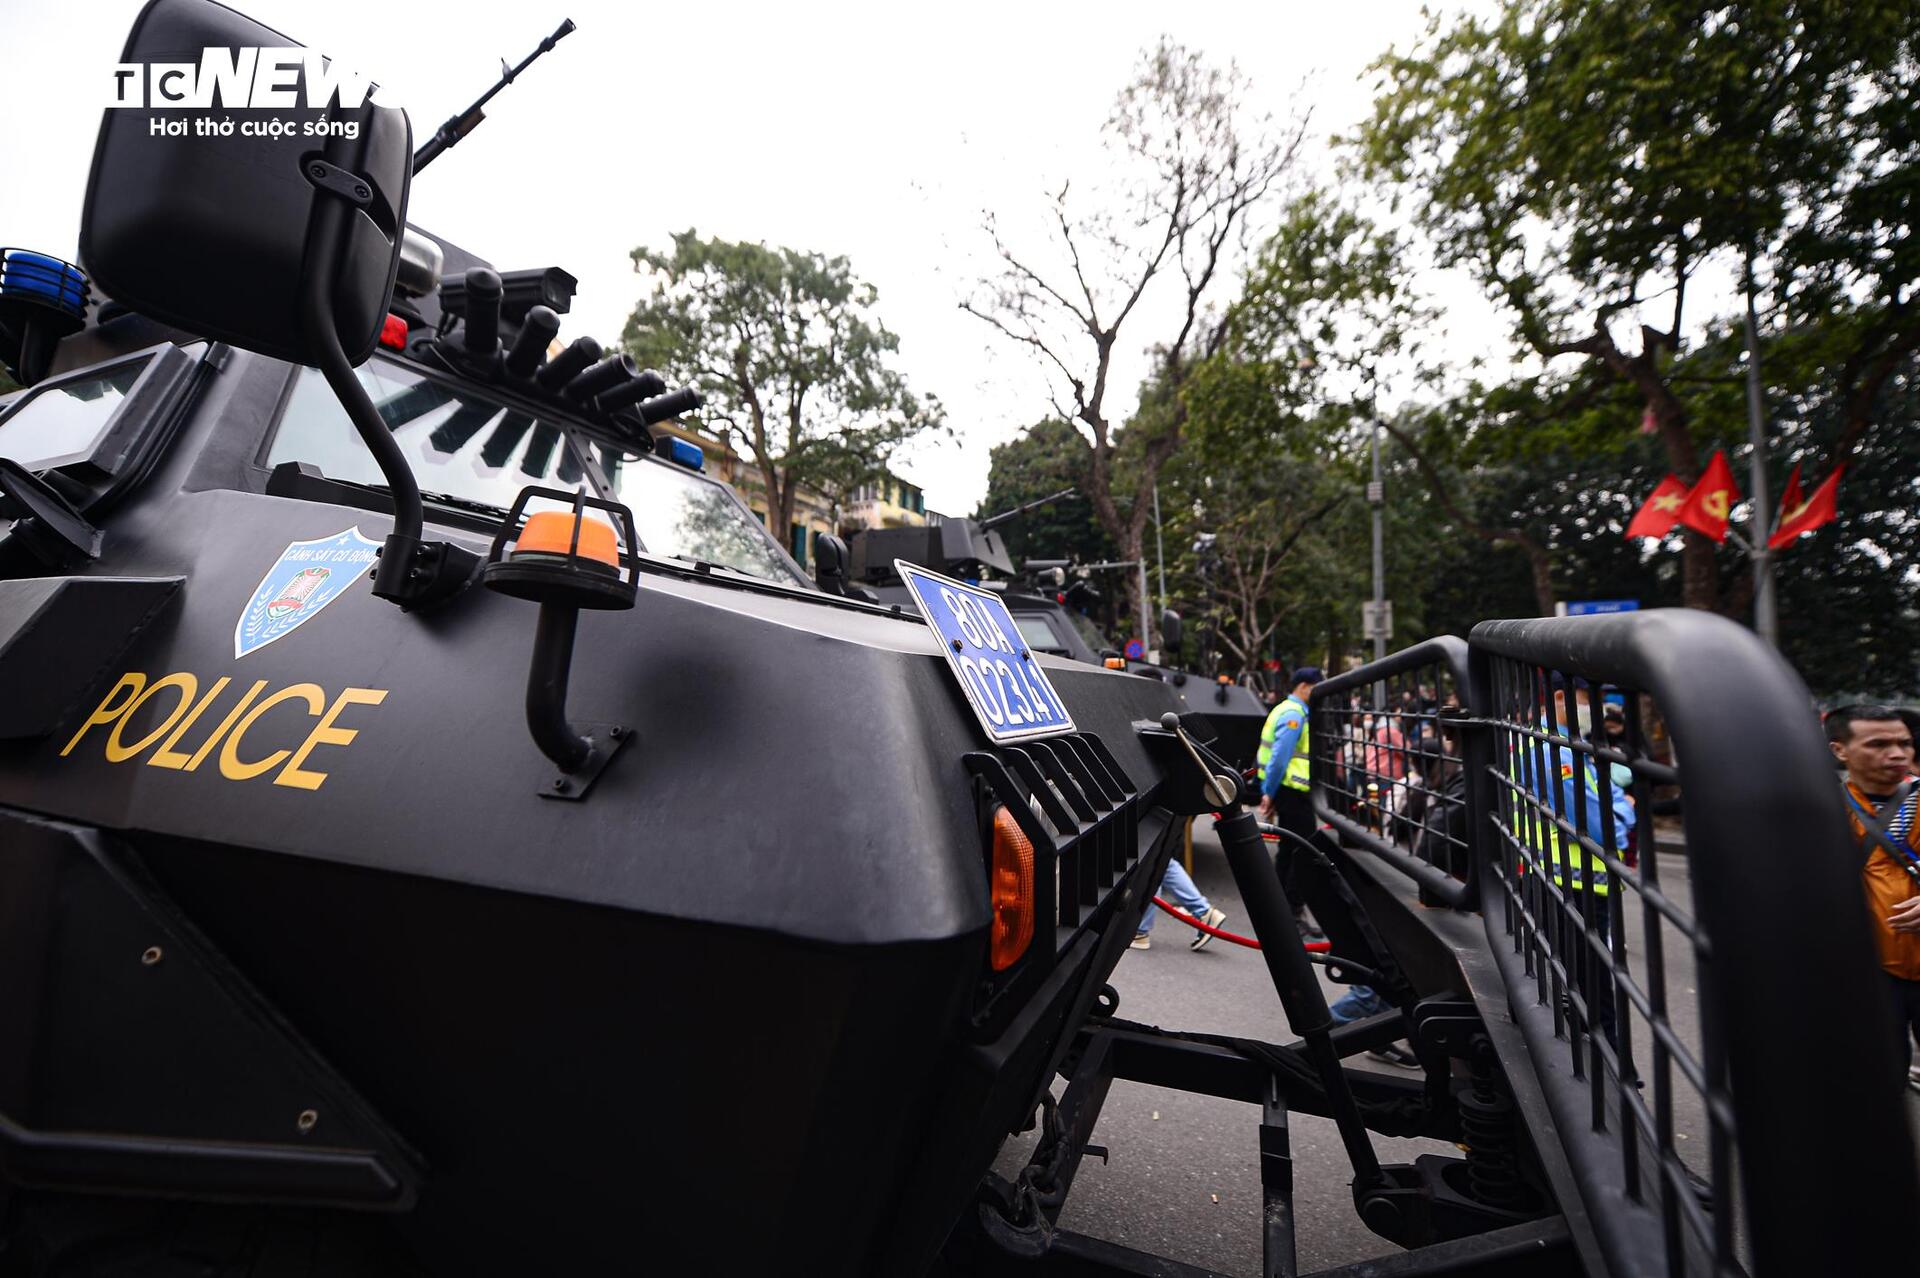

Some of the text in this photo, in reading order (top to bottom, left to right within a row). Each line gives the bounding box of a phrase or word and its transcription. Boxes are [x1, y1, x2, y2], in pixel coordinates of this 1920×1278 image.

[940, 587, 1016, 655] 80A
[960, 655, 1064, 725] 023.41
[59, 671, 389, 790] POLICE
